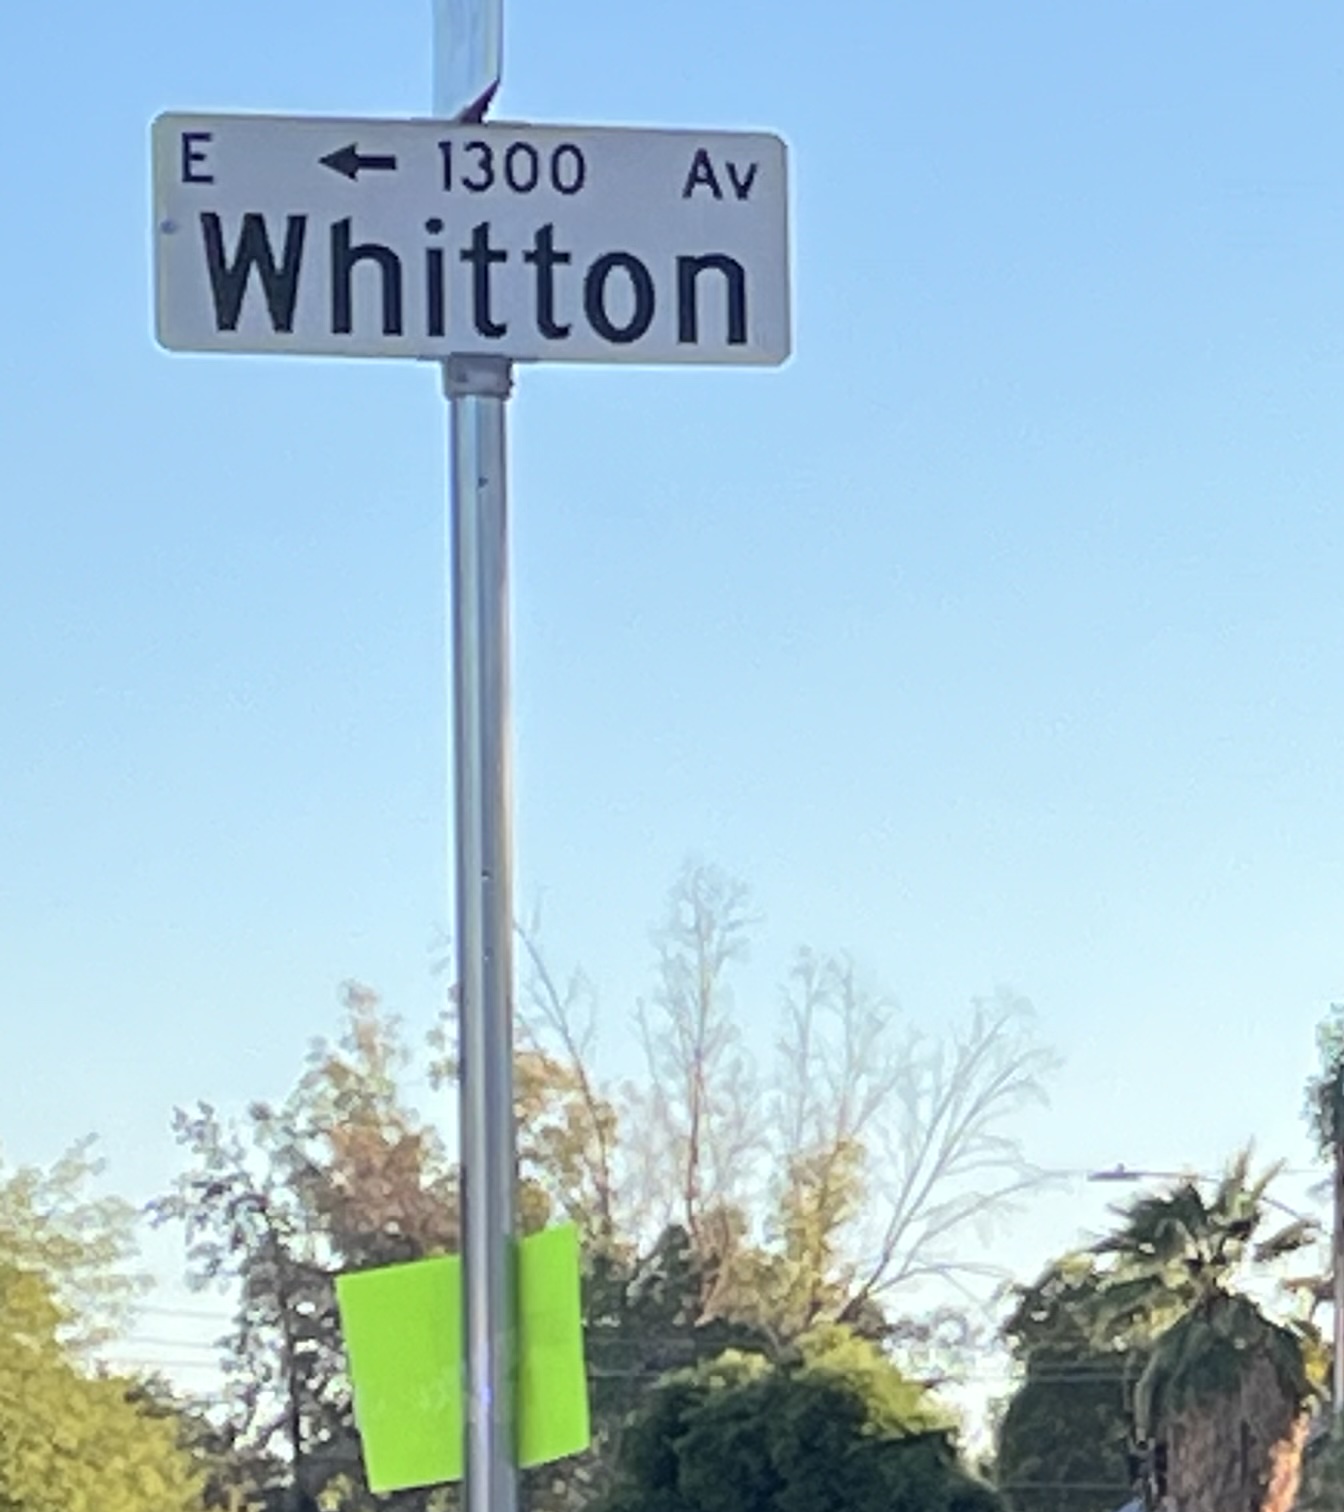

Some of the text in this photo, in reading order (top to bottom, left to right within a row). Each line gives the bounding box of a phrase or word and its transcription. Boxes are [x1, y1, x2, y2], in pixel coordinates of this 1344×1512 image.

[180, 132, 759, 200] E 1300 Av
[200, 211, 748, 346] Whitton
